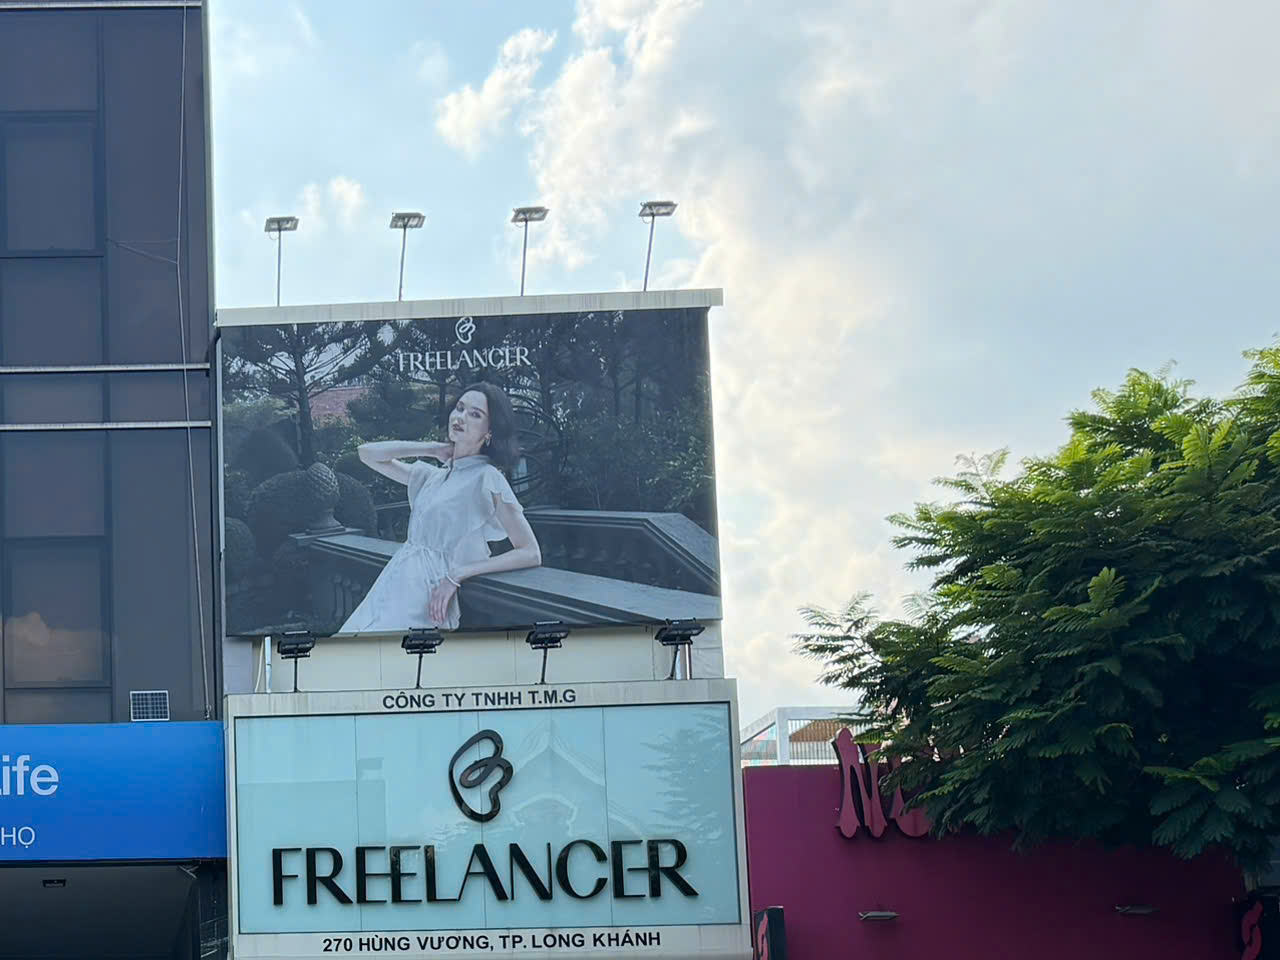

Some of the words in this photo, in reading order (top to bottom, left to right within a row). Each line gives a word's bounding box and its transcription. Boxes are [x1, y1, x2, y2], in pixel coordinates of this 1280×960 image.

[399, 346, 532, 372] FREELANCER
[382, 691, 436, 709] CÔNG
[441, 692, 466, 707] TY
[471, 691, 522, 707] TNHH
[527, 689, 577, 705] T.M.G
[271, 838, 700, 906] FREELANCER
[322, 937, 353, 953] 270
[358, 934, 410, 952] HÙNG
[417, 935, 494, 952] VƯƠNG,
[498, 934, 527, 950] TP.
[531, 933, 585, 949] LONG
[592, 930, 661, 948] KHÁNH
